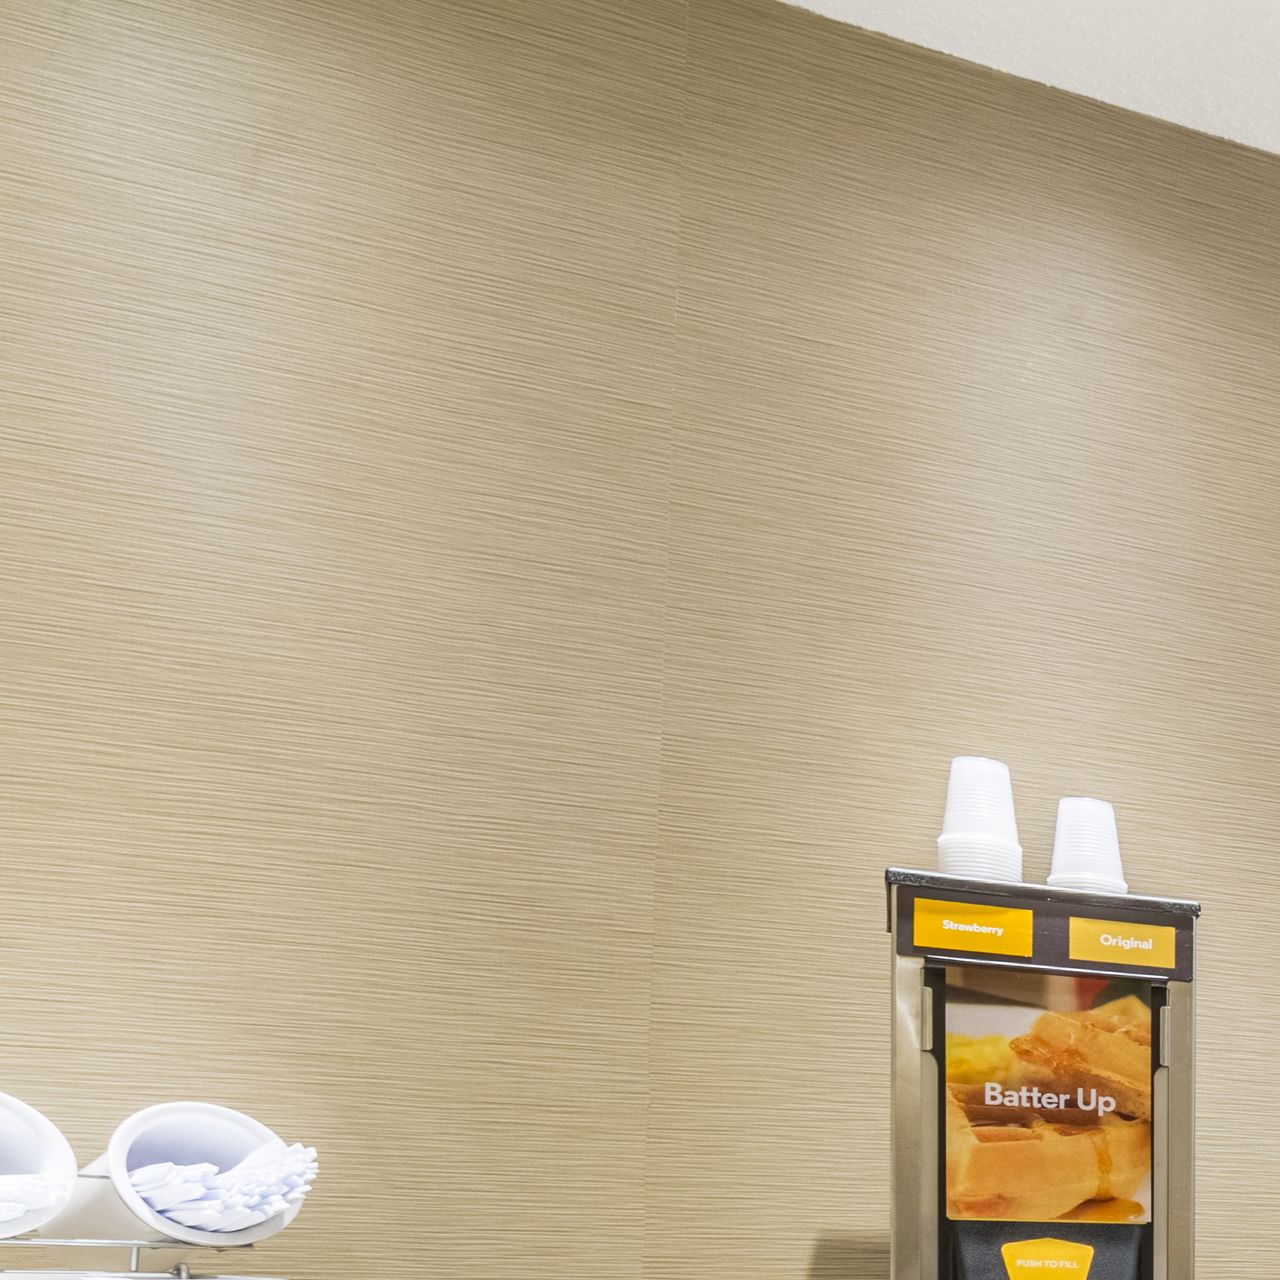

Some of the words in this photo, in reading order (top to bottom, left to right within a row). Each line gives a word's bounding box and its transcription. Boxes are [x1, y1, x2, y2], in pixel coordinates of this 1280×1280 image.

[942, 919, 1004, 937] Strawberry
[1100, 933, 1153, 950] Original
[984, 1081, 1070, 1109] Batter
[1077, 1087, 1117, 1116] Up
[1016, 1258, 1042, 1268] PUSH
[1043, 1260, 1058, 1268] TO
[1059, 1261, 1079, 1269] FILL
